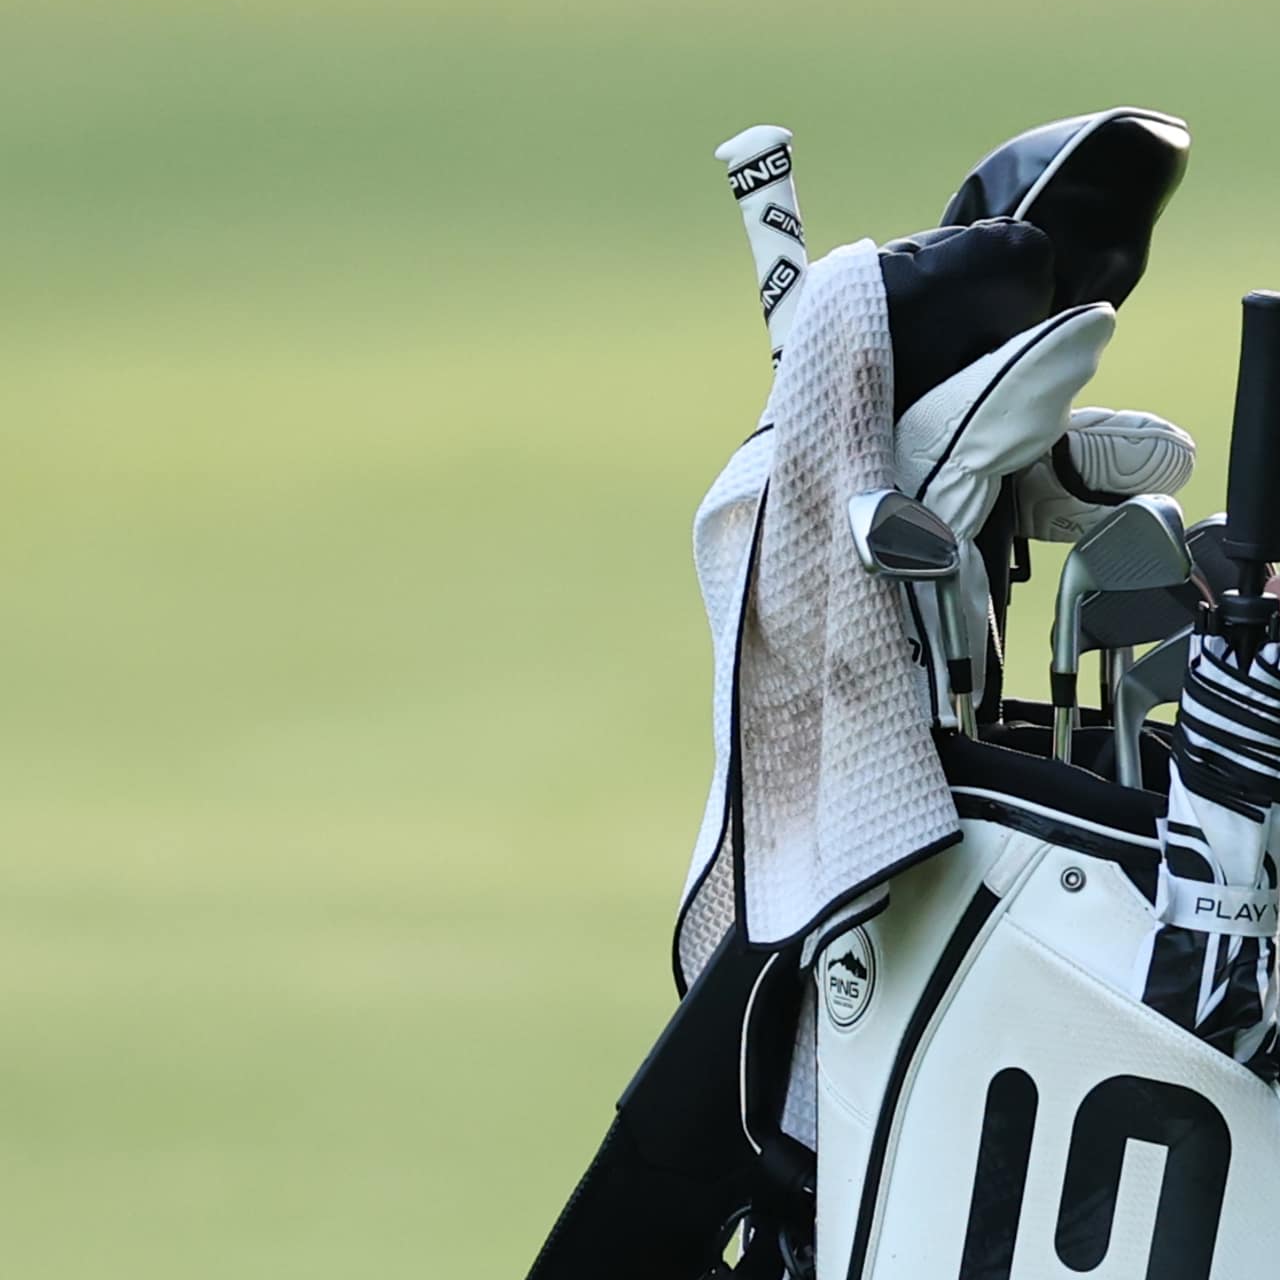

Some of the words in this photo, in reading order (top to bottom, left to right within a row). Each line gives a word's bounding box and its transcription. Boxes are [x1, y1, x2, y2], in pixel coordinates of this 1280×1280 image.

[765, 209, 803, 237] PIN
[761, 264, 795, 310] ING
[1195, 896, 1268, 923] PLAY
[829, 976, 859, 999] PING
